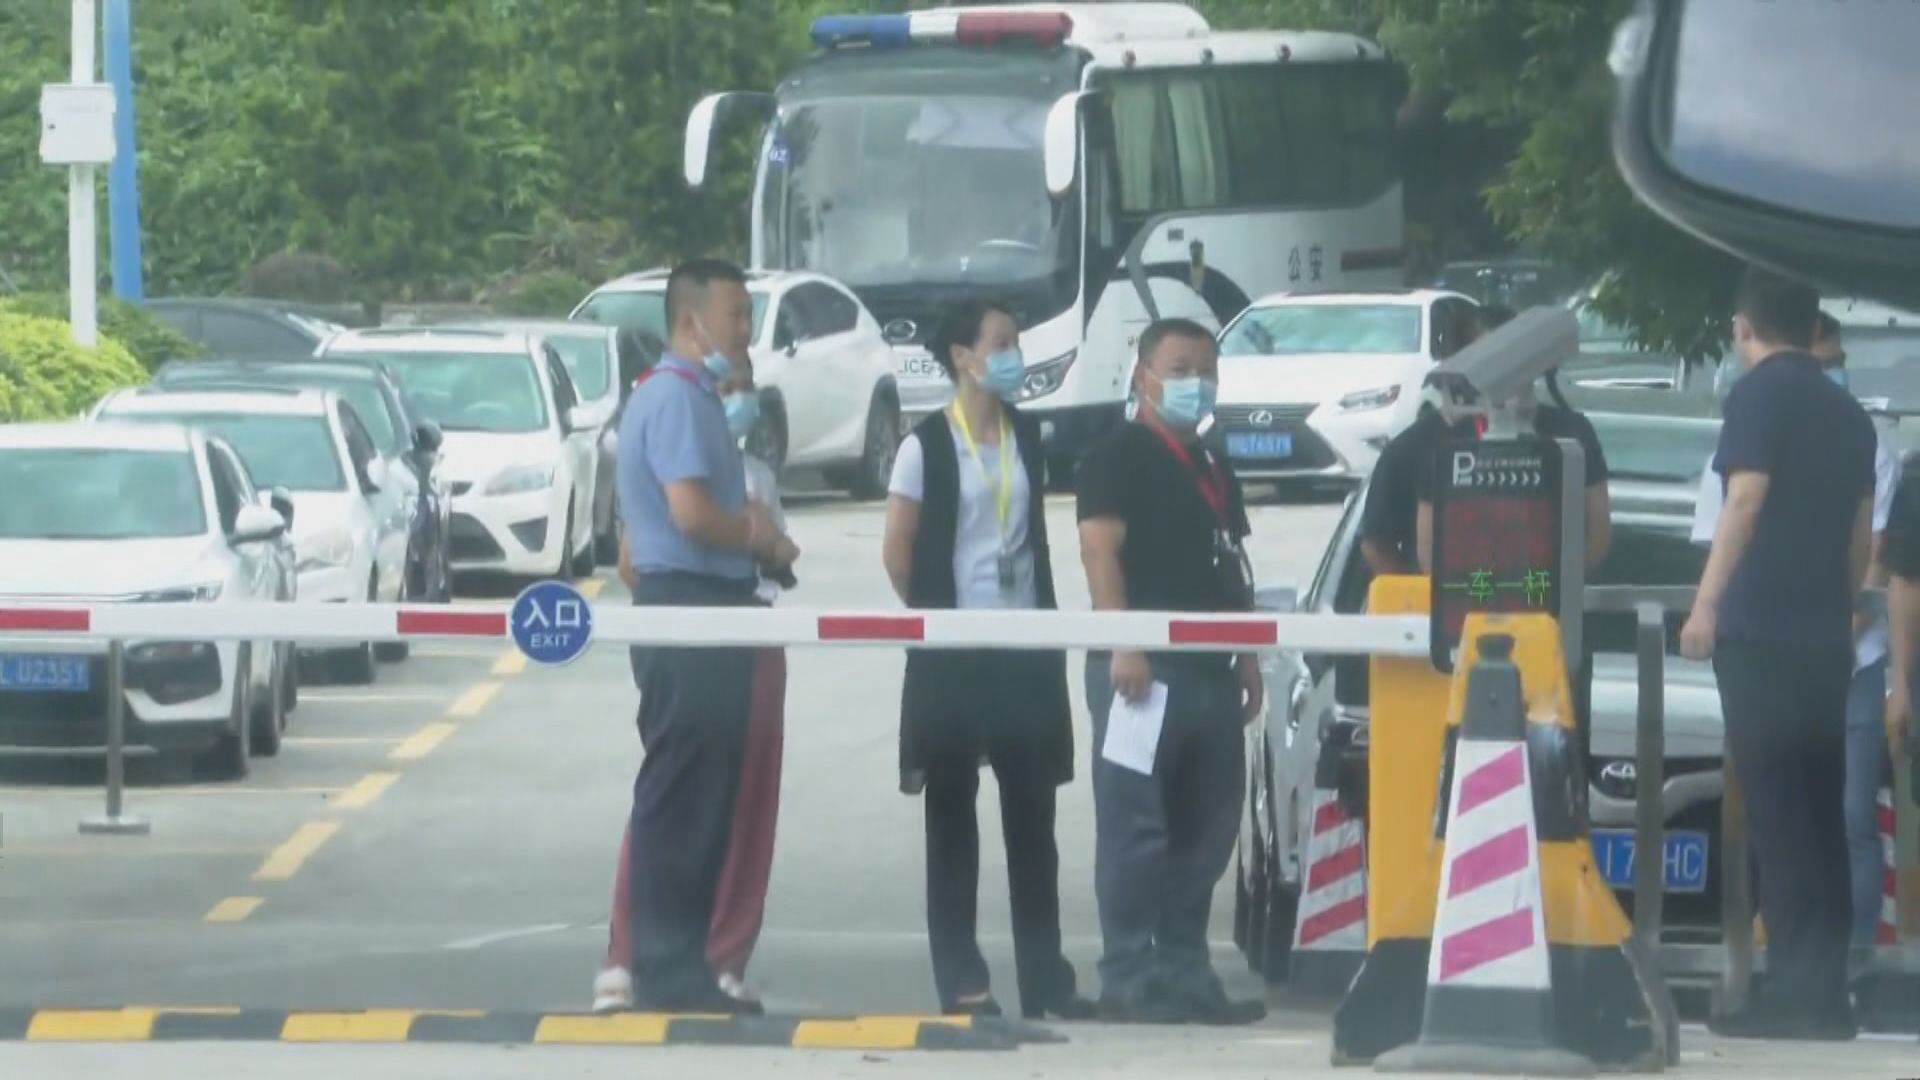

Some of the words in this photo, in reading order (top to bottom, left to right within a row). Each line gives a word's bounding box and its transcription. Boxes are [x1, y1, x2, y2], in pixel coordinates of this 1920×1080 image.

[1287, 245, 1323, 283] 公安
[1442, 568, 1551, 606] 一车一杆
[523, 598, 581, 628] 入口
[530, 633, 570, 648] EXIT
